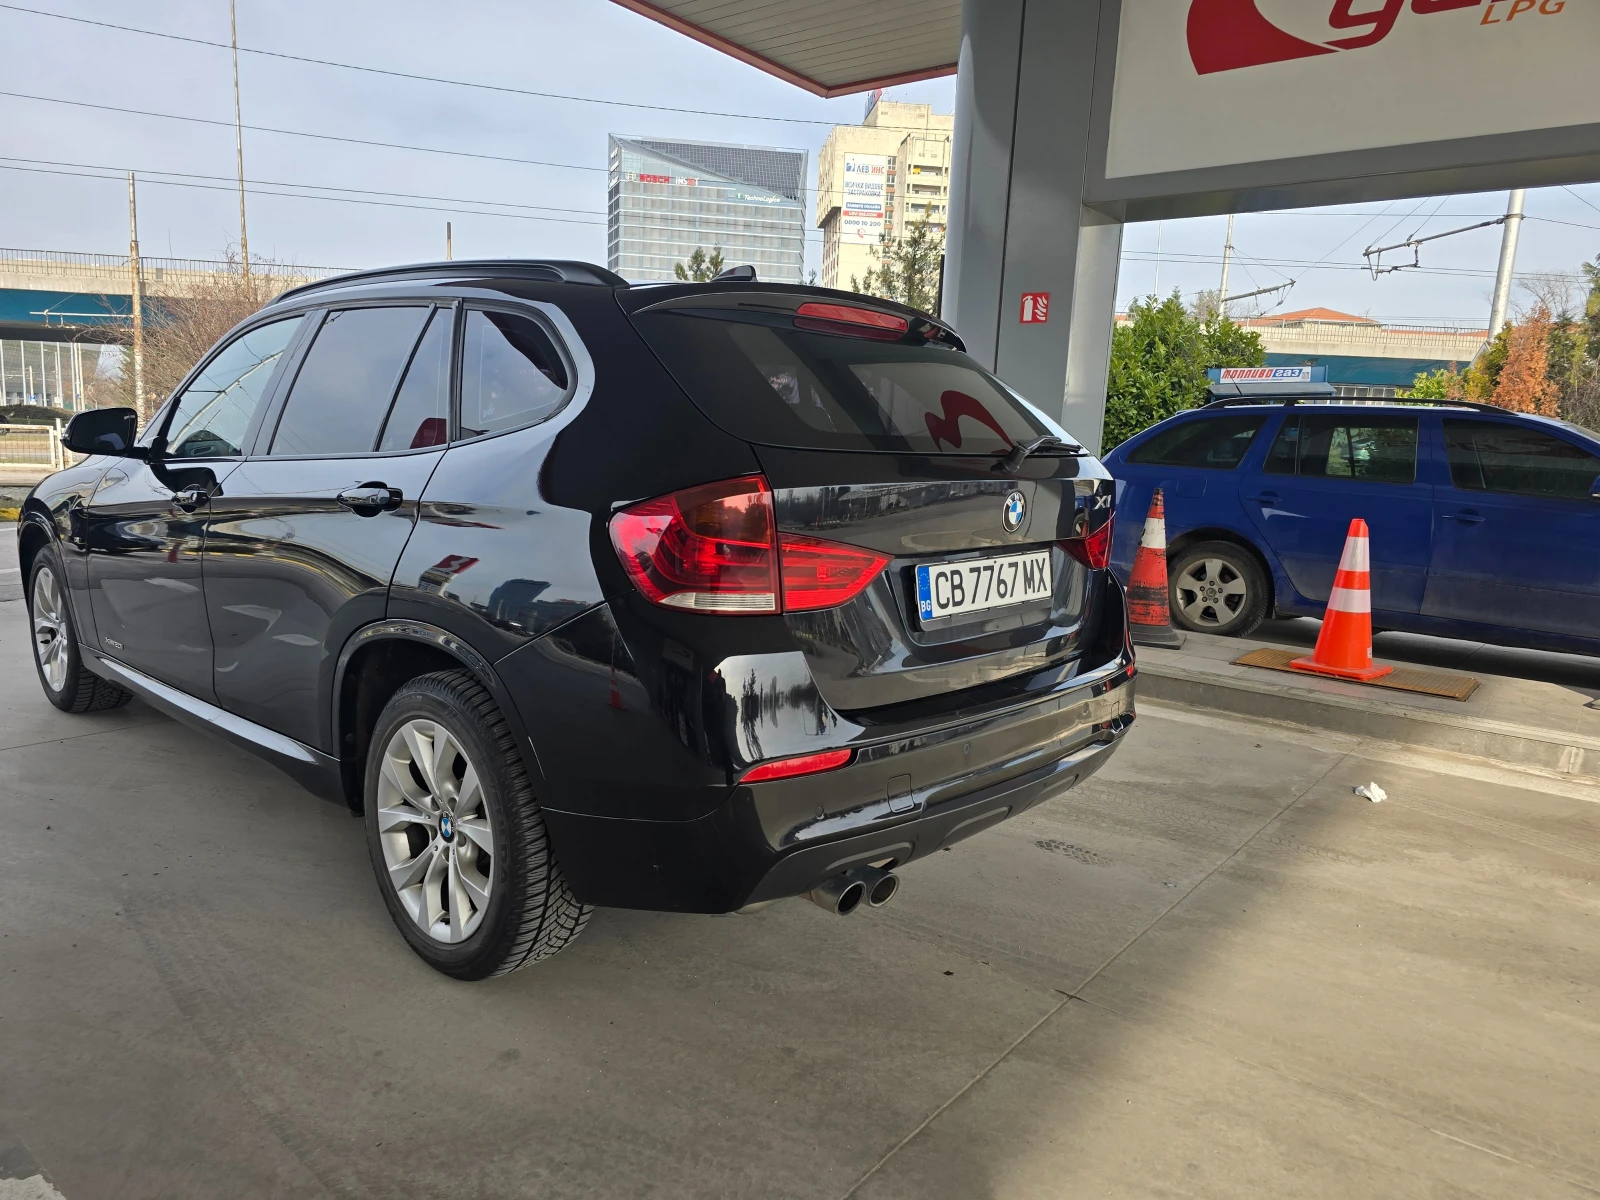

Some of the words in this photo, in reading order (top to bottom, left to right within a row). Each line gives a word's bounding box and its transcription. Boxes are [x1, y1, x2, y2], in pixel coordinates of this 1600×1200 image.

[1480, 0, 1566, 25] LPG
[856, 165, 870, 173] ЛЕВ
[871, 166, 885, 174] ИНС
[639, 174, 671, 184] BOSCH
[845, 181, 864, 189] ВСИЧКИ
[1094, 495, 1111, 510] X1
[935, 569, 965, 610] CB
[969, 561, 1019, 604] 7767
[1023, 557, 1048, 595] MX
[920, 600, 931, 613] BG
